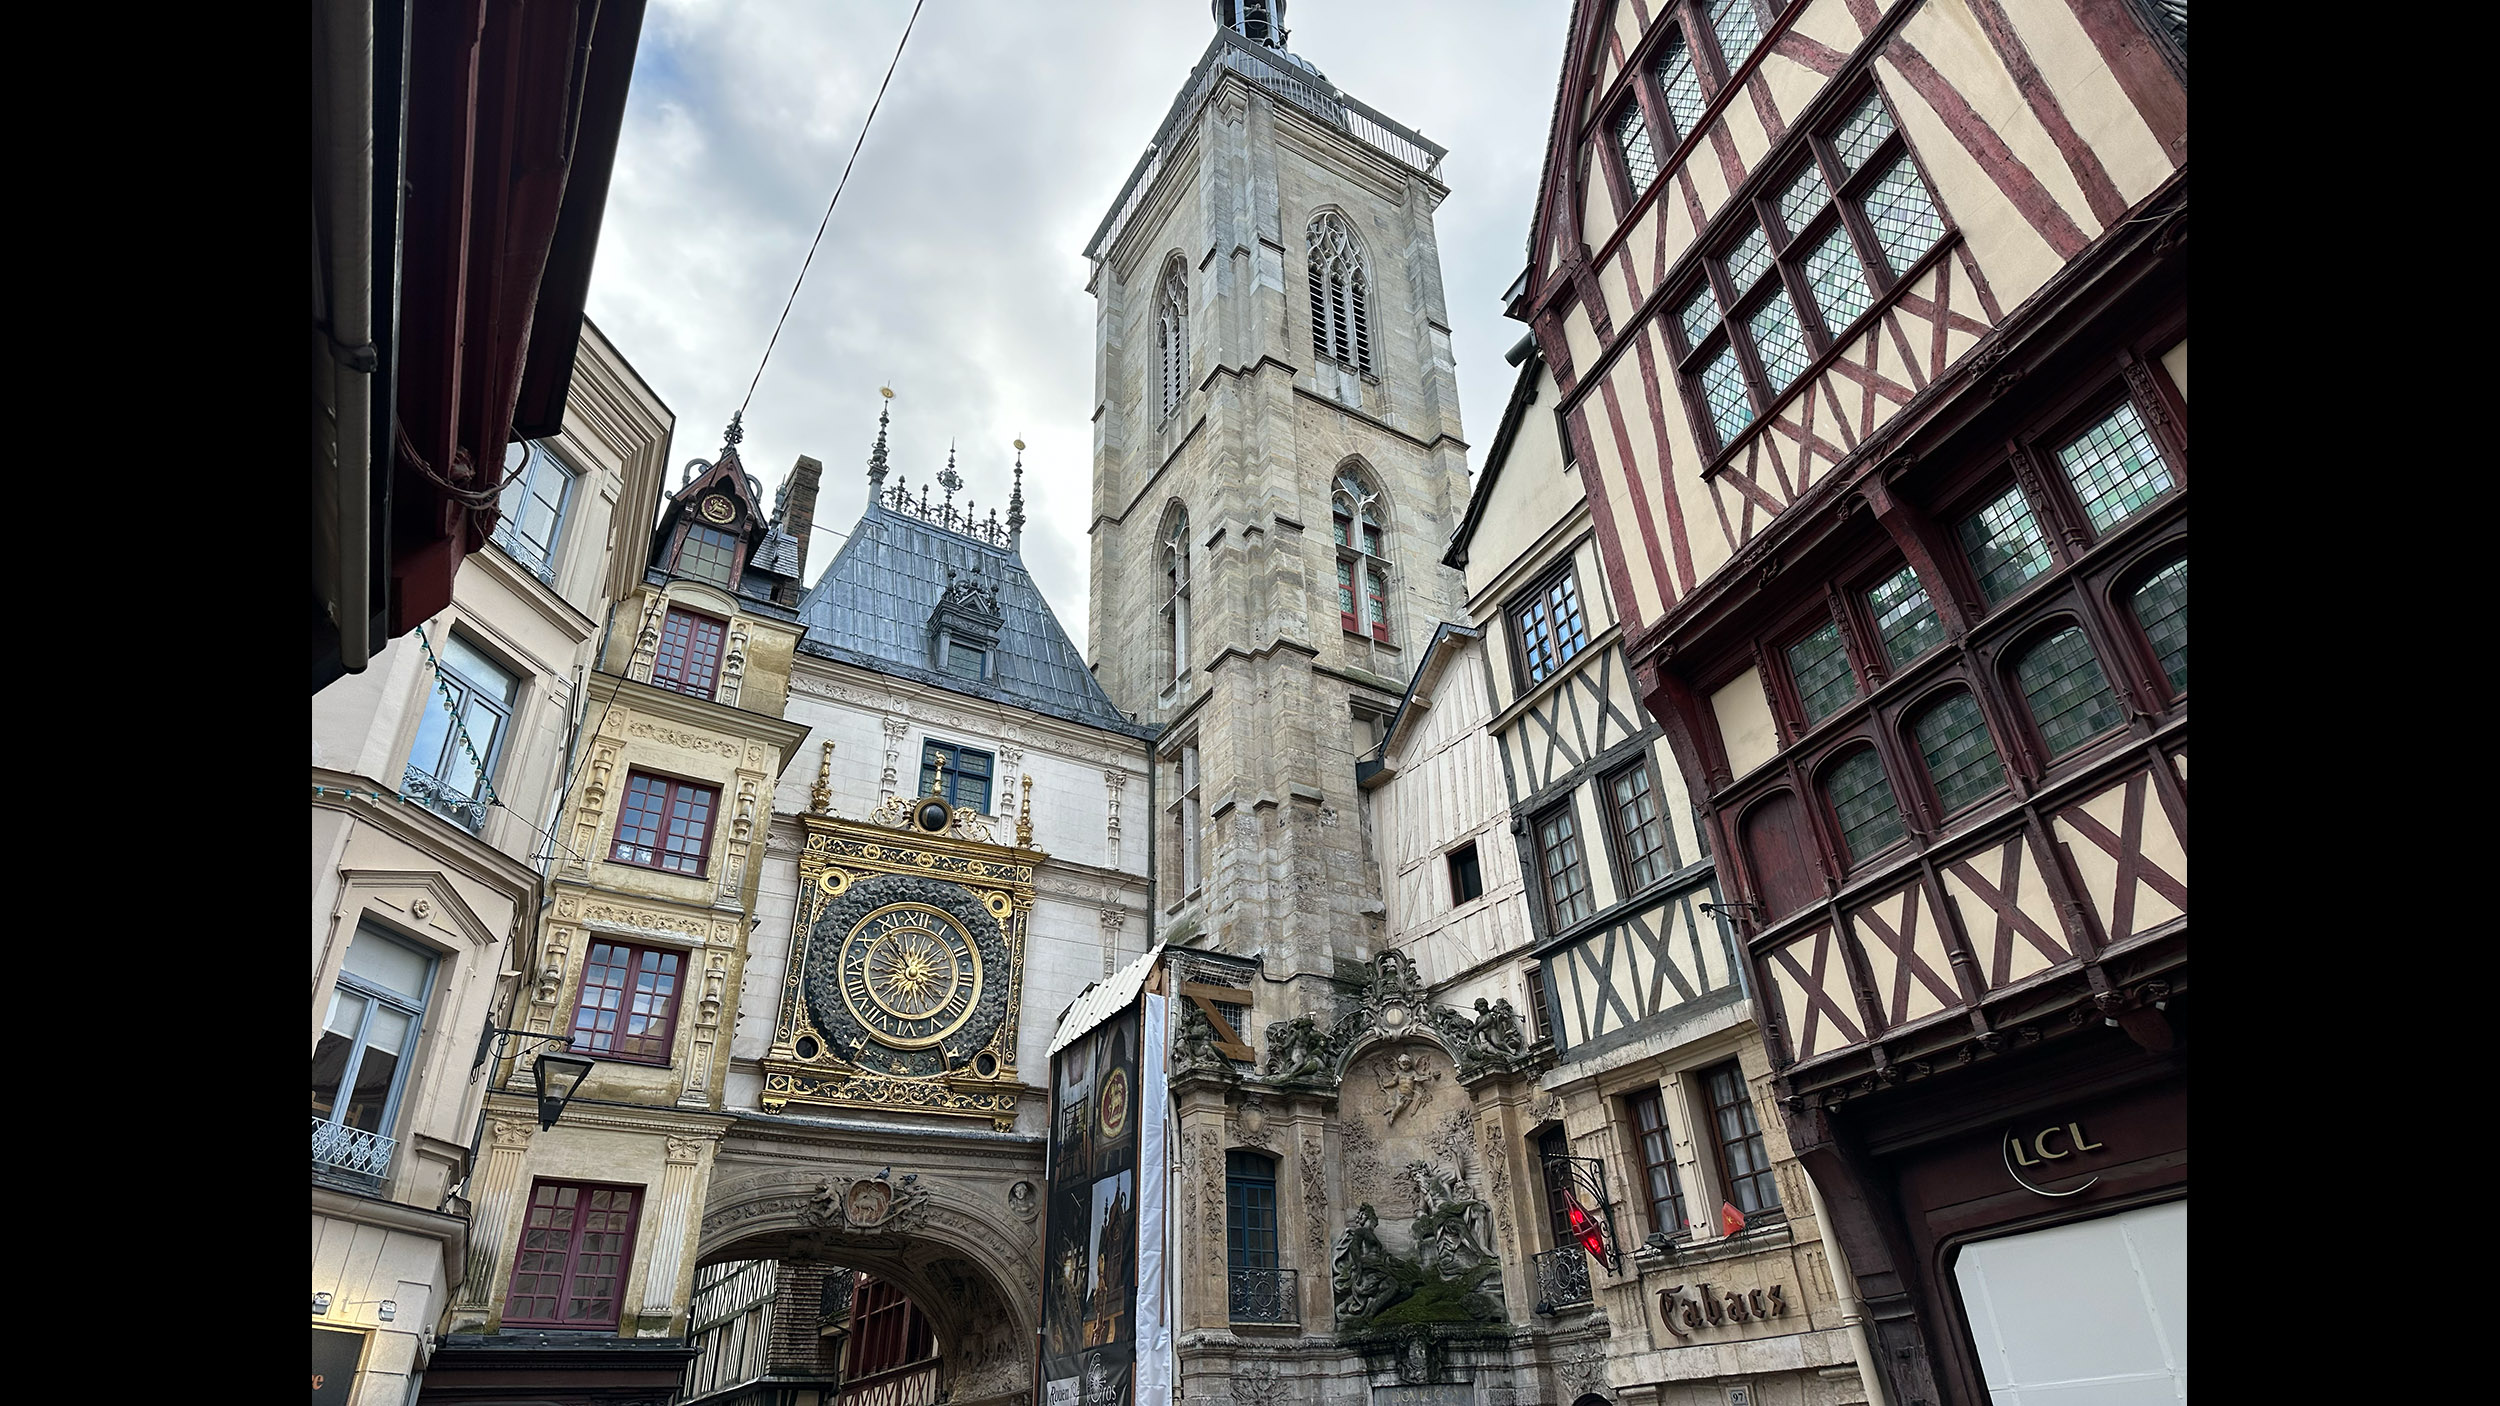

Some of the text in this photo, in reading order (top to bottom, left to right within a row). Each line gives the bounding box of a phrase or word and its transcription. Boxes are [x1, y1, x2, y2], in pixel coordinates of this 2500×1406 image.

[876, 913, 900, 934] XI
[903, 911, 930, 928] XII
[855, 930, 876, 949] X
[953, 945, 970, 958] II
[846, 955, 866, 975] IX
[958, 972, 974, 988] III
[896, 1020, 917, 1037] VI
[930, 1017, 944, 1033] V
[2012, 1122, 2102, 1166] LCL
[1655, 1283, 1786, 1339] Tabacs
[1732, 1392, 1743, 1402] 97
